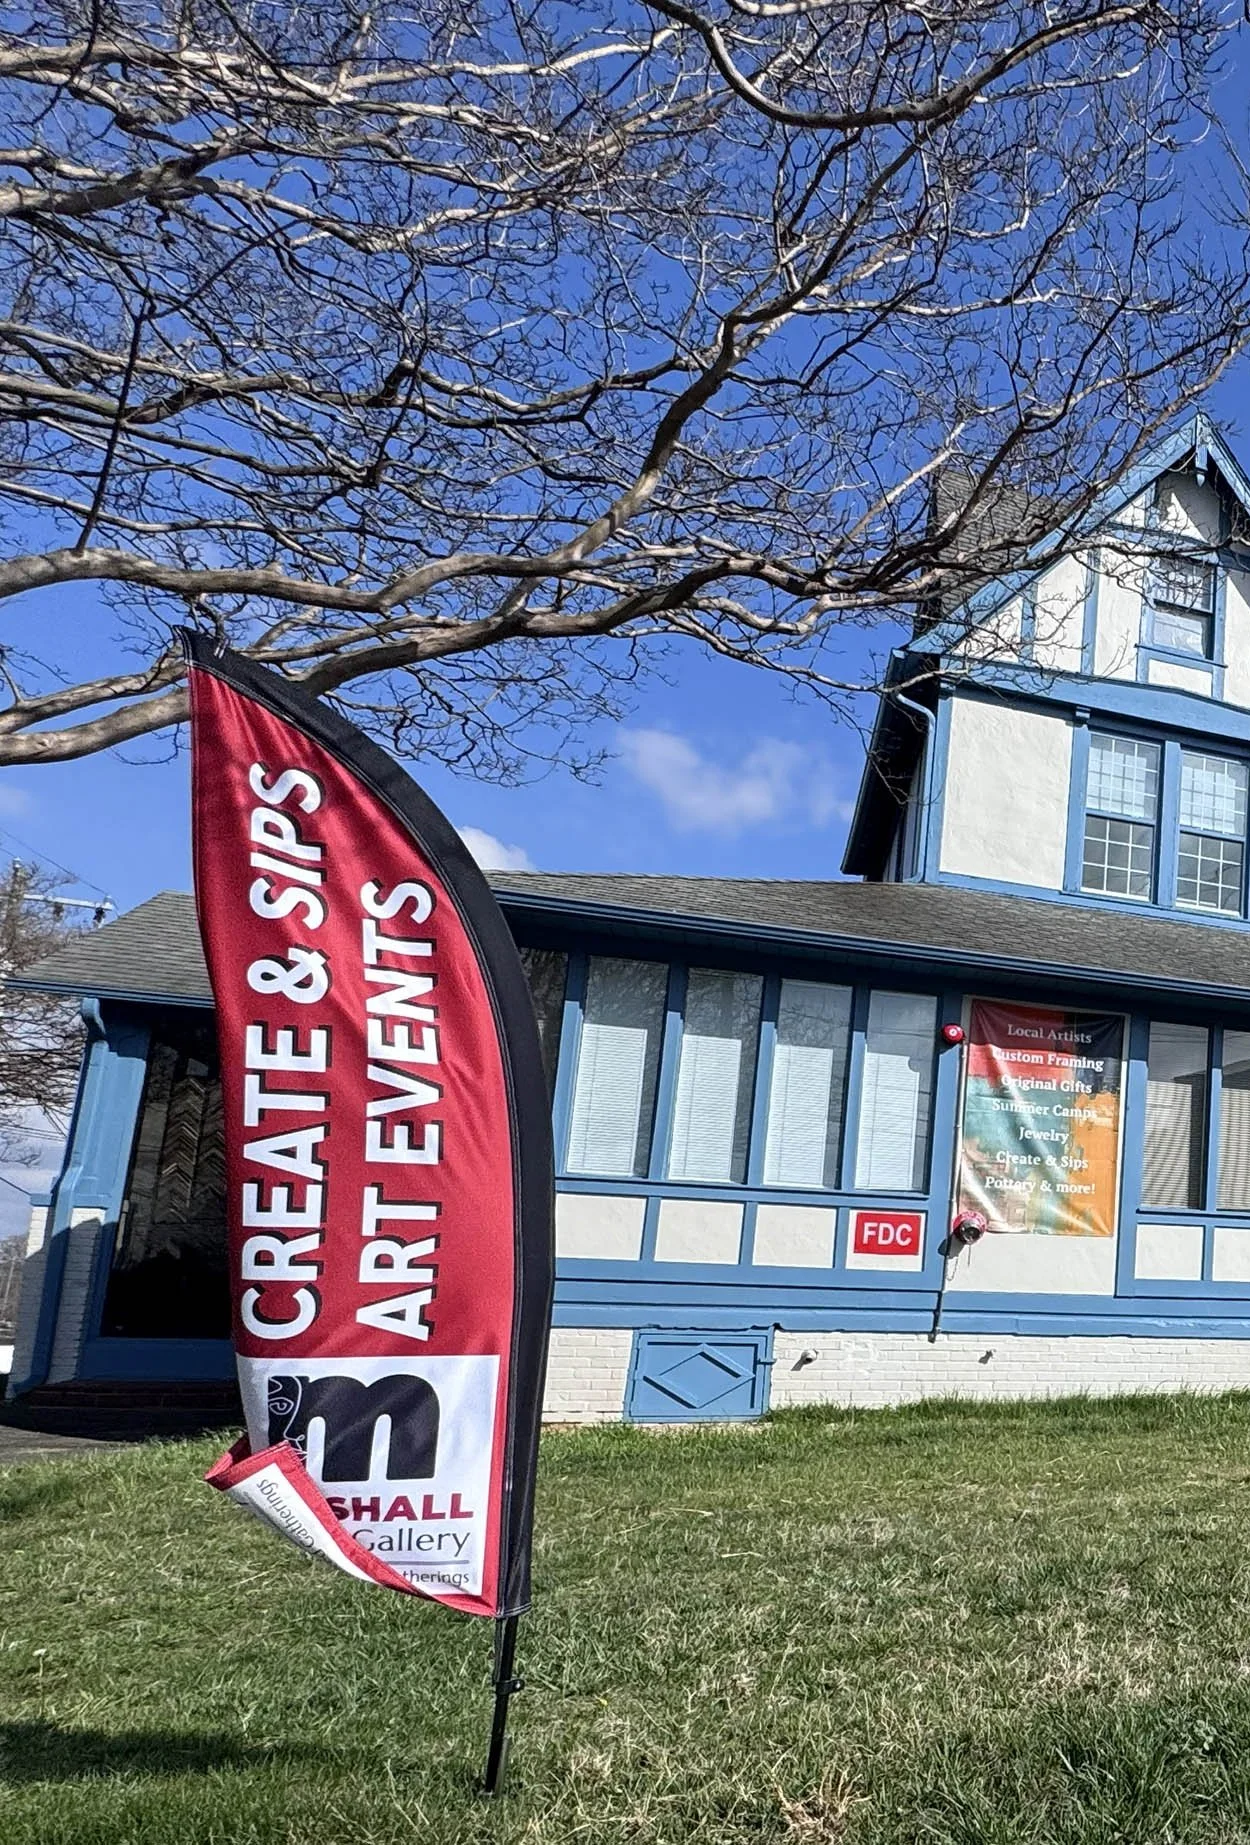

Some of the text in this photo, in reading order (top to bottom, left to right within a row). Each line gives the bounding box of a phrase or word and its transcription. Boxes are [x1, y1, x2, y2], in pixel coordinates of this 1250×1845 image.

[1007, 1023, 1092, 1044] Local Artists
[241, 761, 331, 1340] CREATE & SIPS
[992, 1048, 1104, 1072] Custom Framing
[1001, 1074, 1093, 1094] Original Gifts
[356, 879, 442, 1342] ART EVENTS
[991, 1100, 1098, 1119] Summer Camps
[1018, 1126, 1070, 1144] Jewelry
[996, 1151, 1089, 1169] Create & Sips
[985, 1176, 1096, 1194] Pottery & more!
[862, 1222, 913, 1247] FDC
[256, 1478, 316, 1549] Gatherings
[325, 1492, 475, 1522] SHALL
[352, 1527, 472, 1557] Gallery
[402, 1569, 470, 1588] therings
